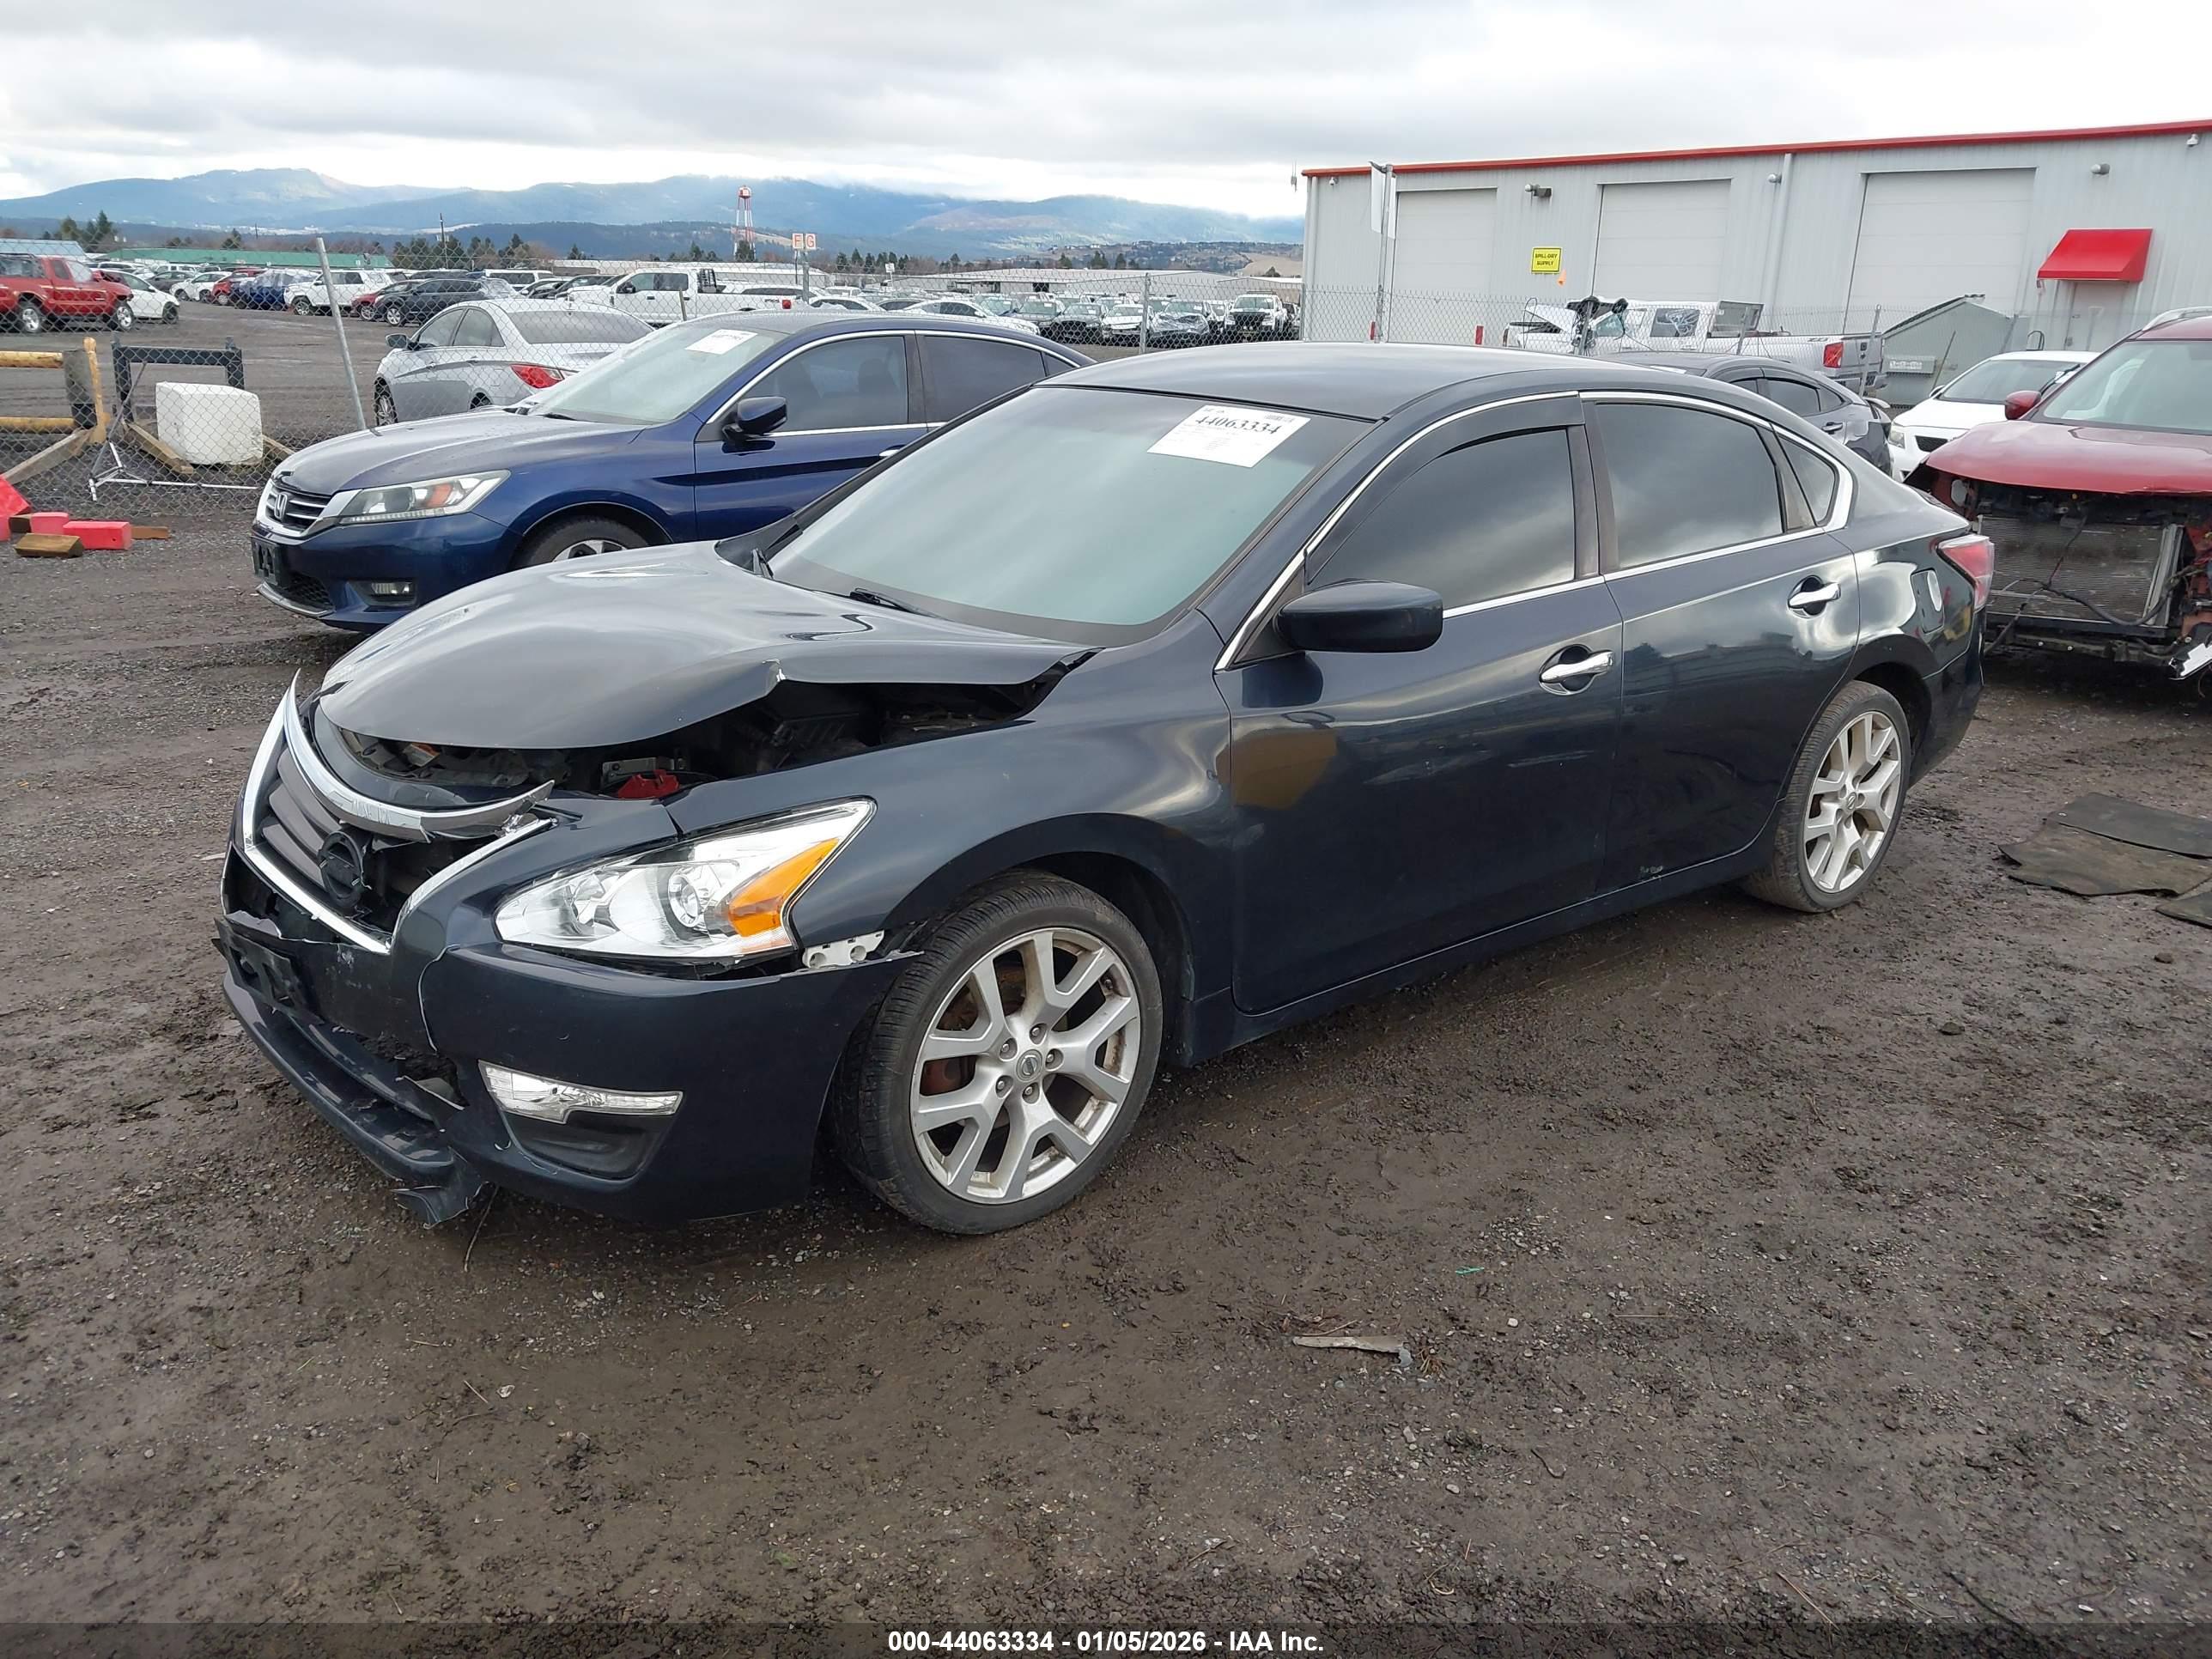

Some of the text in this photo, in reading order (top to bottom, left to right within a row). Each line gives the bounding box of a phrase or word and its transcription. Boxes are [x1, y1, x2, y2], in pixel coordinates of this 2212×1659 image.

[793, 234, 802, 248] F
[806, 234, 815, 248] G
[1195, 415, 1282, 434] 44063334
